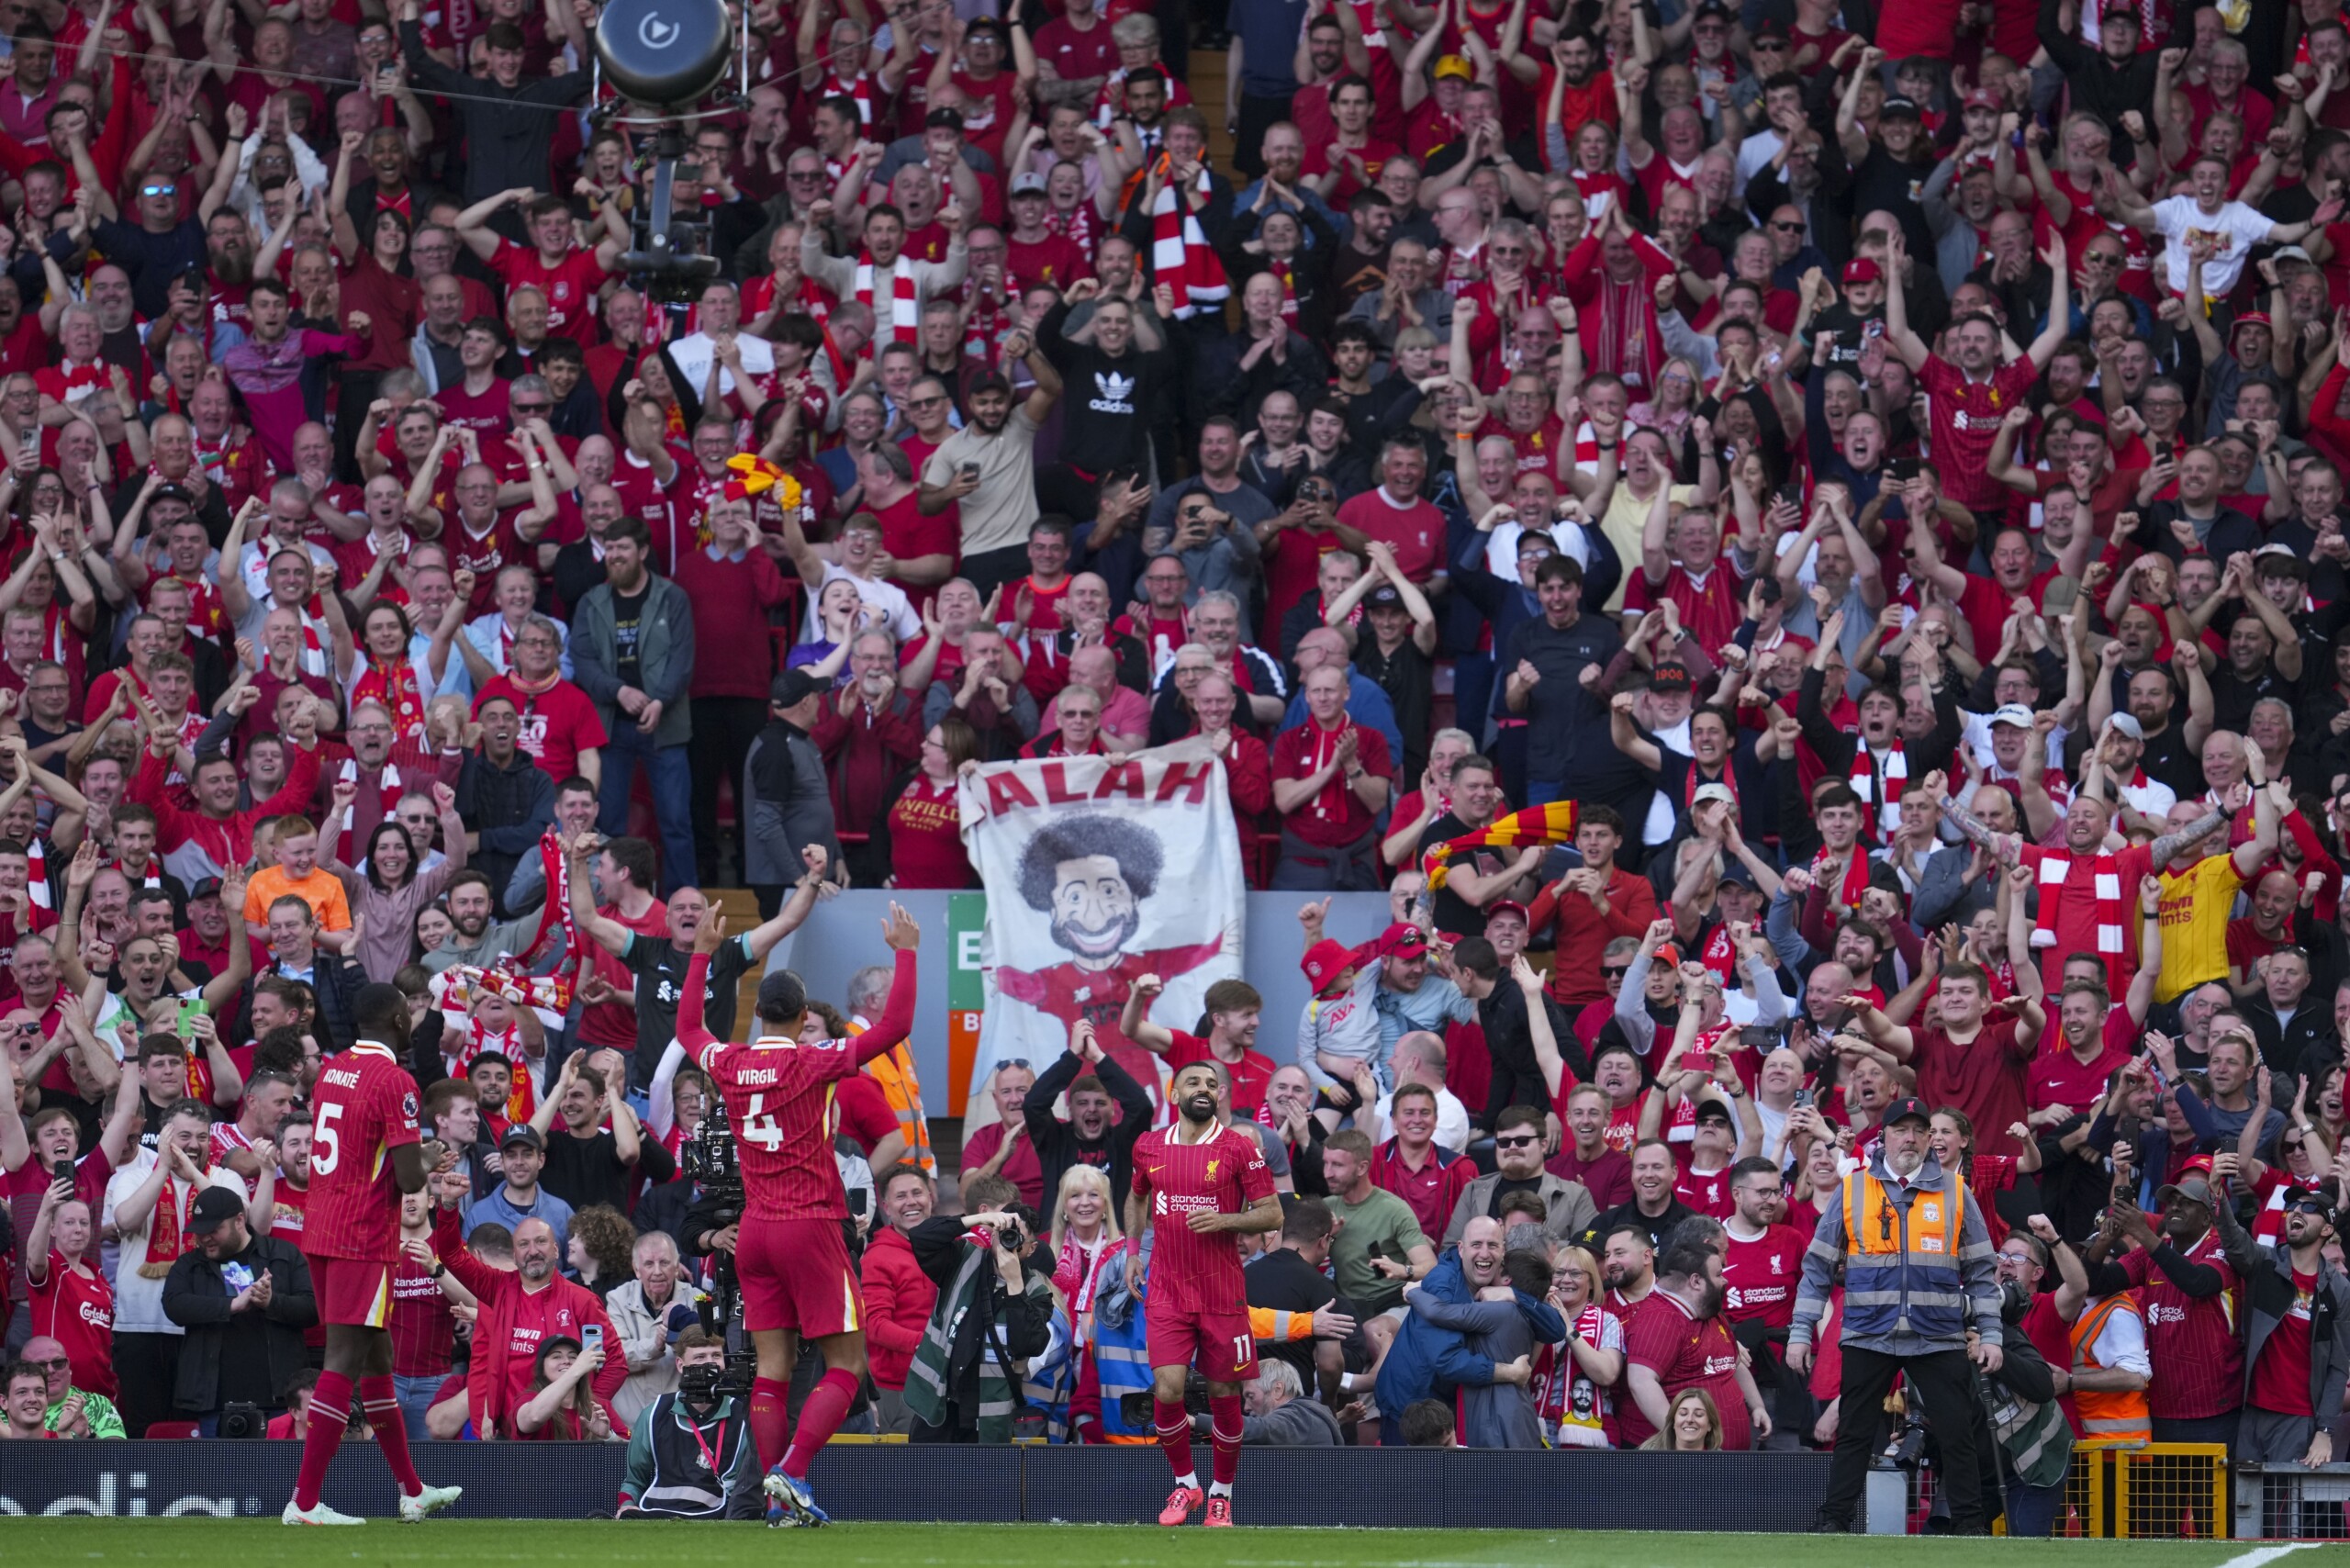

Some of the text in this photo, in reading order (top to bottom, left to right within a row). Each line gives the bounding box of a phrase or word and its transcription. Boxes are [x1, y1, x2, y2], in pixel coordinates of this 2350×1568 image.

[1089, 398, 1134, 414] adidas
[323, 1070, 361, 1090] KONATÉ
[737, 1069, 778, 1085] VIRGIL
[742, 1093, 784, 1151] 4
[311, 1102, 343, 1175] 5
[1170, 1194, 1216, 1204] standard
[393, 1285, 434, 1298] hartered
[1743, 1285, 1785, 1297] standard
[1744, 1293, 1786, 1304] chartered
[1234, 1334, 1251, 1362] 11
